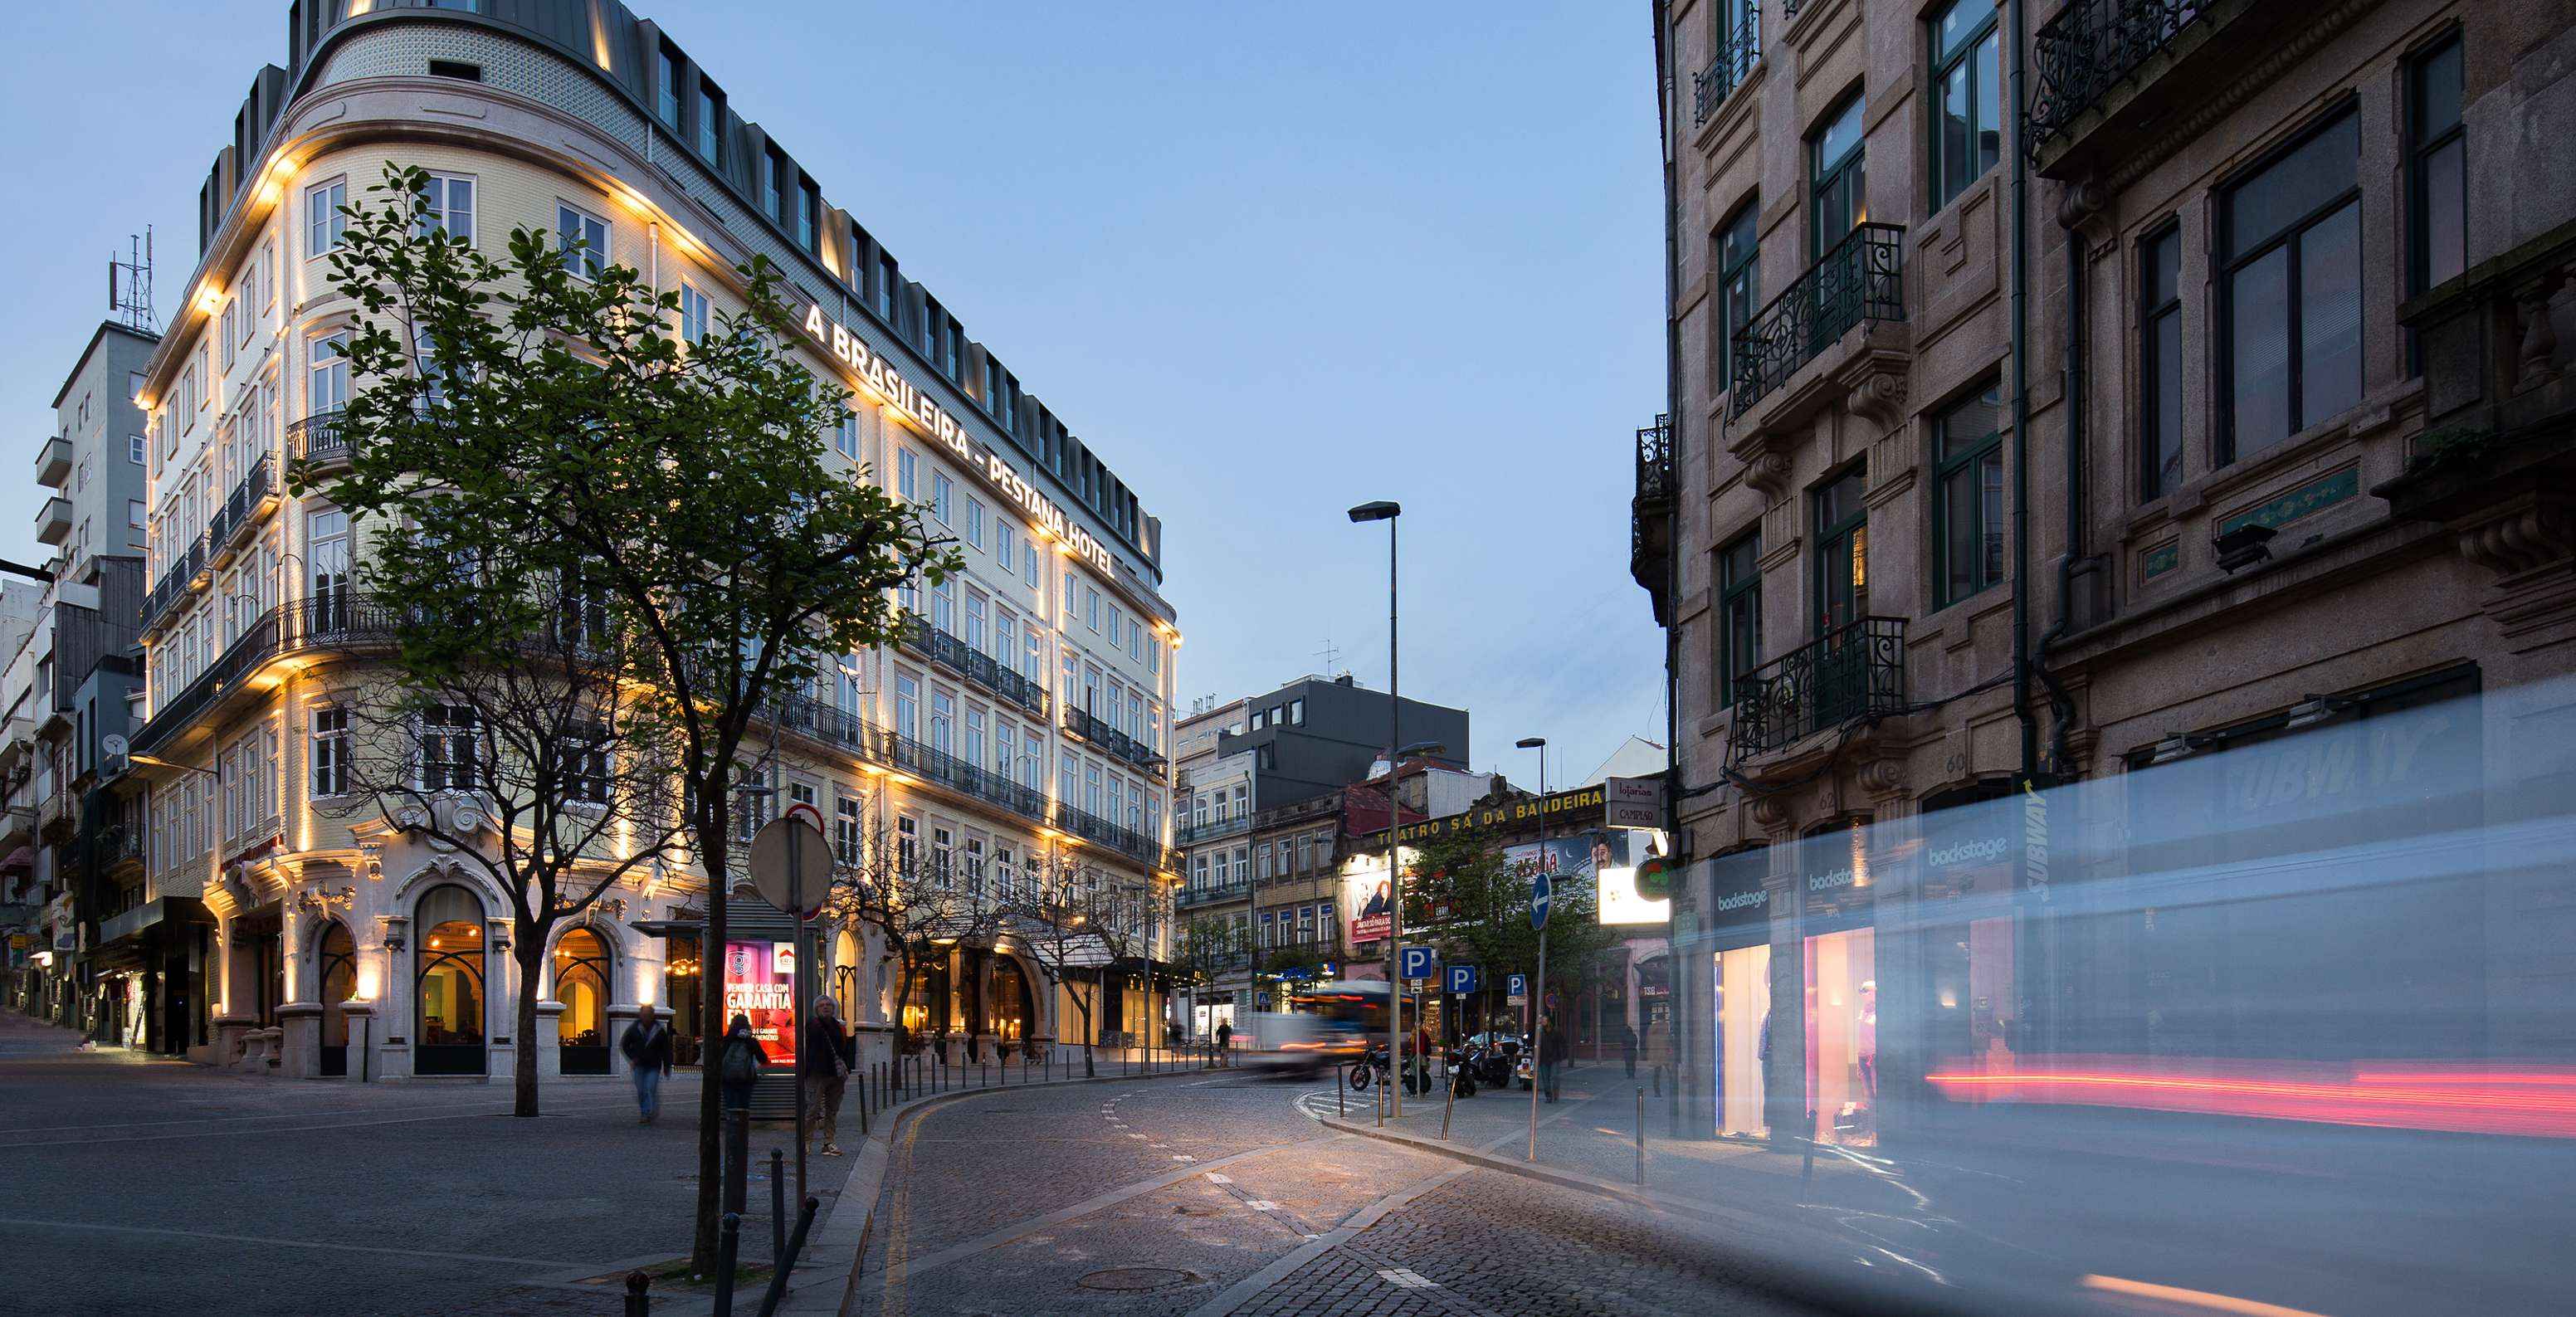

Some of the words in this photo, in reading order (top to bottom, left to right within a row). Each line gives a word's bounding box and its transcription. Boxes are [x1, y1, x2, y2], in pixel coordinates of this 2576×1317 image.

[806, 304, 826, 343] A
[833, 323, 969, 459] BRASILEIRA
[990, 455, 1065, 538] PESTANA
[1069, 521, 1115, 579] HOTEL
[1451, 812, 1473, 830] SÁ
[1483, 810, 1506, 825] DA
[1515, 790, 1603, 819] BANDEIRA
[1929, 837, 2008, 866] backstage
[2025, 779, 2051, 903] SUBWAY
[1809, 867, 1871, 891] backstae
[1718, 889, 1768, 911] backstage
[1408, 950, 1426, 976] P
[727, 983, 754, 993] VENDER
[755, 983, 773, 993] CASA
[774, 983, 789, 993] COM
[1454, 968, 1469, 991] P
[1511, 978, 1521, 994] P
[726, 993, 793, 1010] GARANTIA
